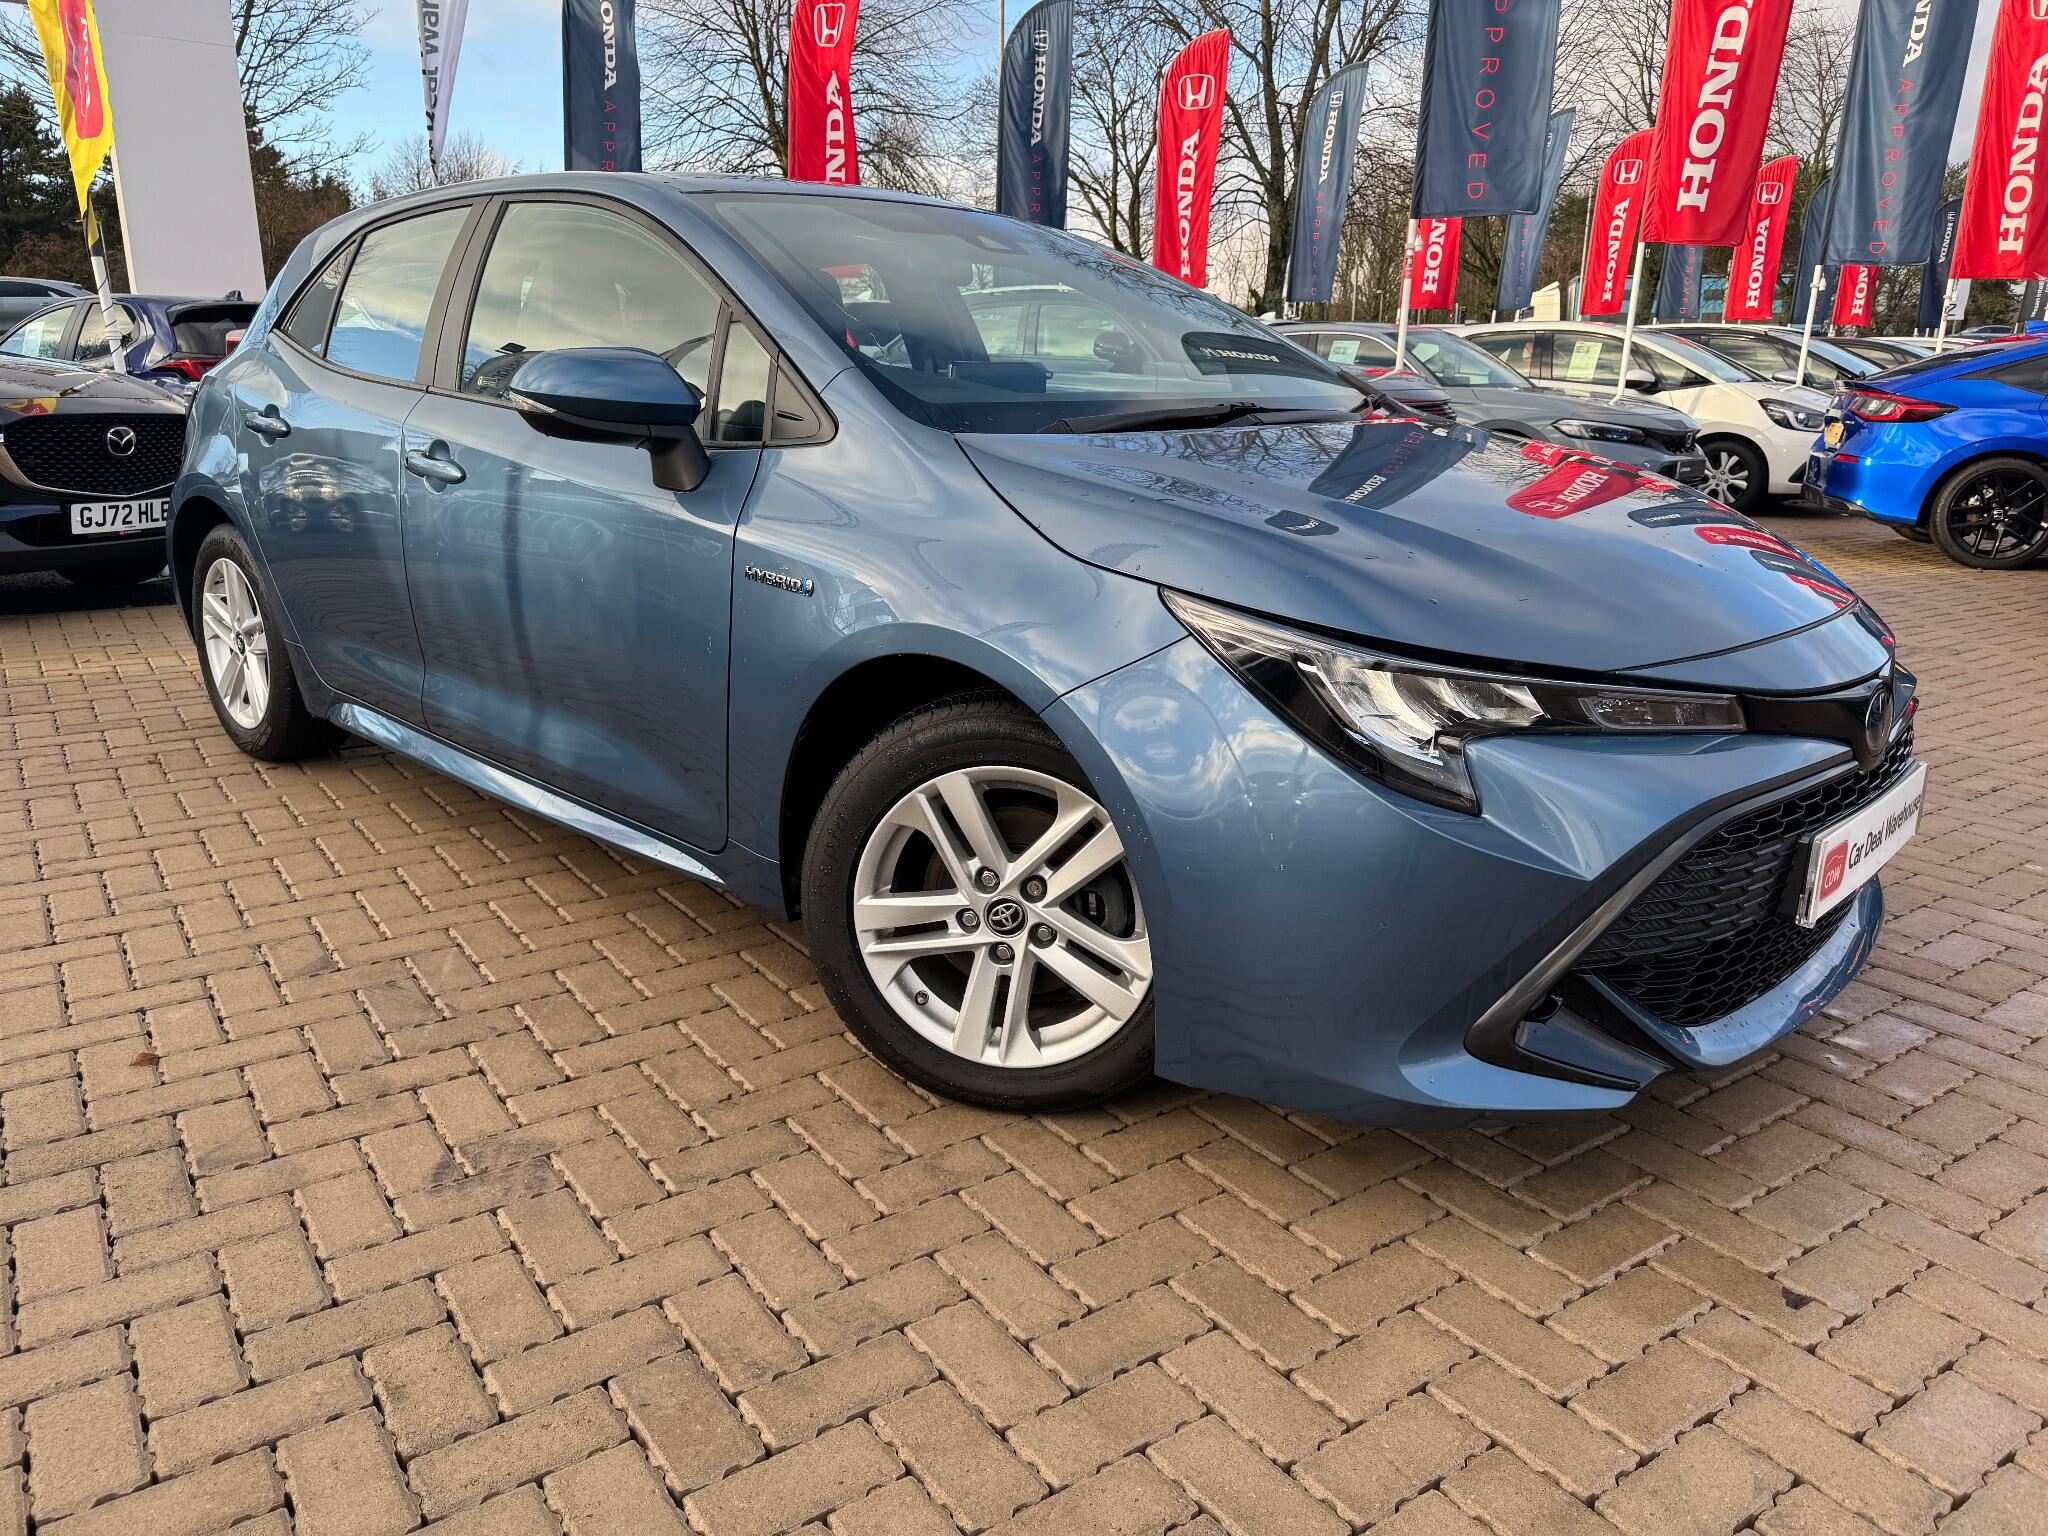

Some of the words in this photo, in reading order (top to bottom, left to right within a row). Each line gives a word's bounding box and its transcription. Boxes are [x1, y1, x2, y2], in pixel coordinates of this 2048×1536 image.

[600, 0, 617, 91] ONDA
[1031, 54, 1046, 147] HONDA
[1676, 0, 1752, 213] HOND
[1030, 153, 1042, 226] APPR
[1319, 109, 1339, 185] HONDA
[1869, 78, 1915, 255] APPROVED
[1997, 52, 2048, 255] HONDA
[1177, 128, 1200, 278] HONDA
[1938, 221, 1954, 263] HONDA
[1602, 198, 1630, 302] HONDA
[1745, 217, 1770, 309] HONDA
[80, 504, 133, 528] GJ72
[1824, 863, 1842, 889] CDW
[1848, 842, 1864, 870] Car
[1864, 822, 1885, 859] Deal
